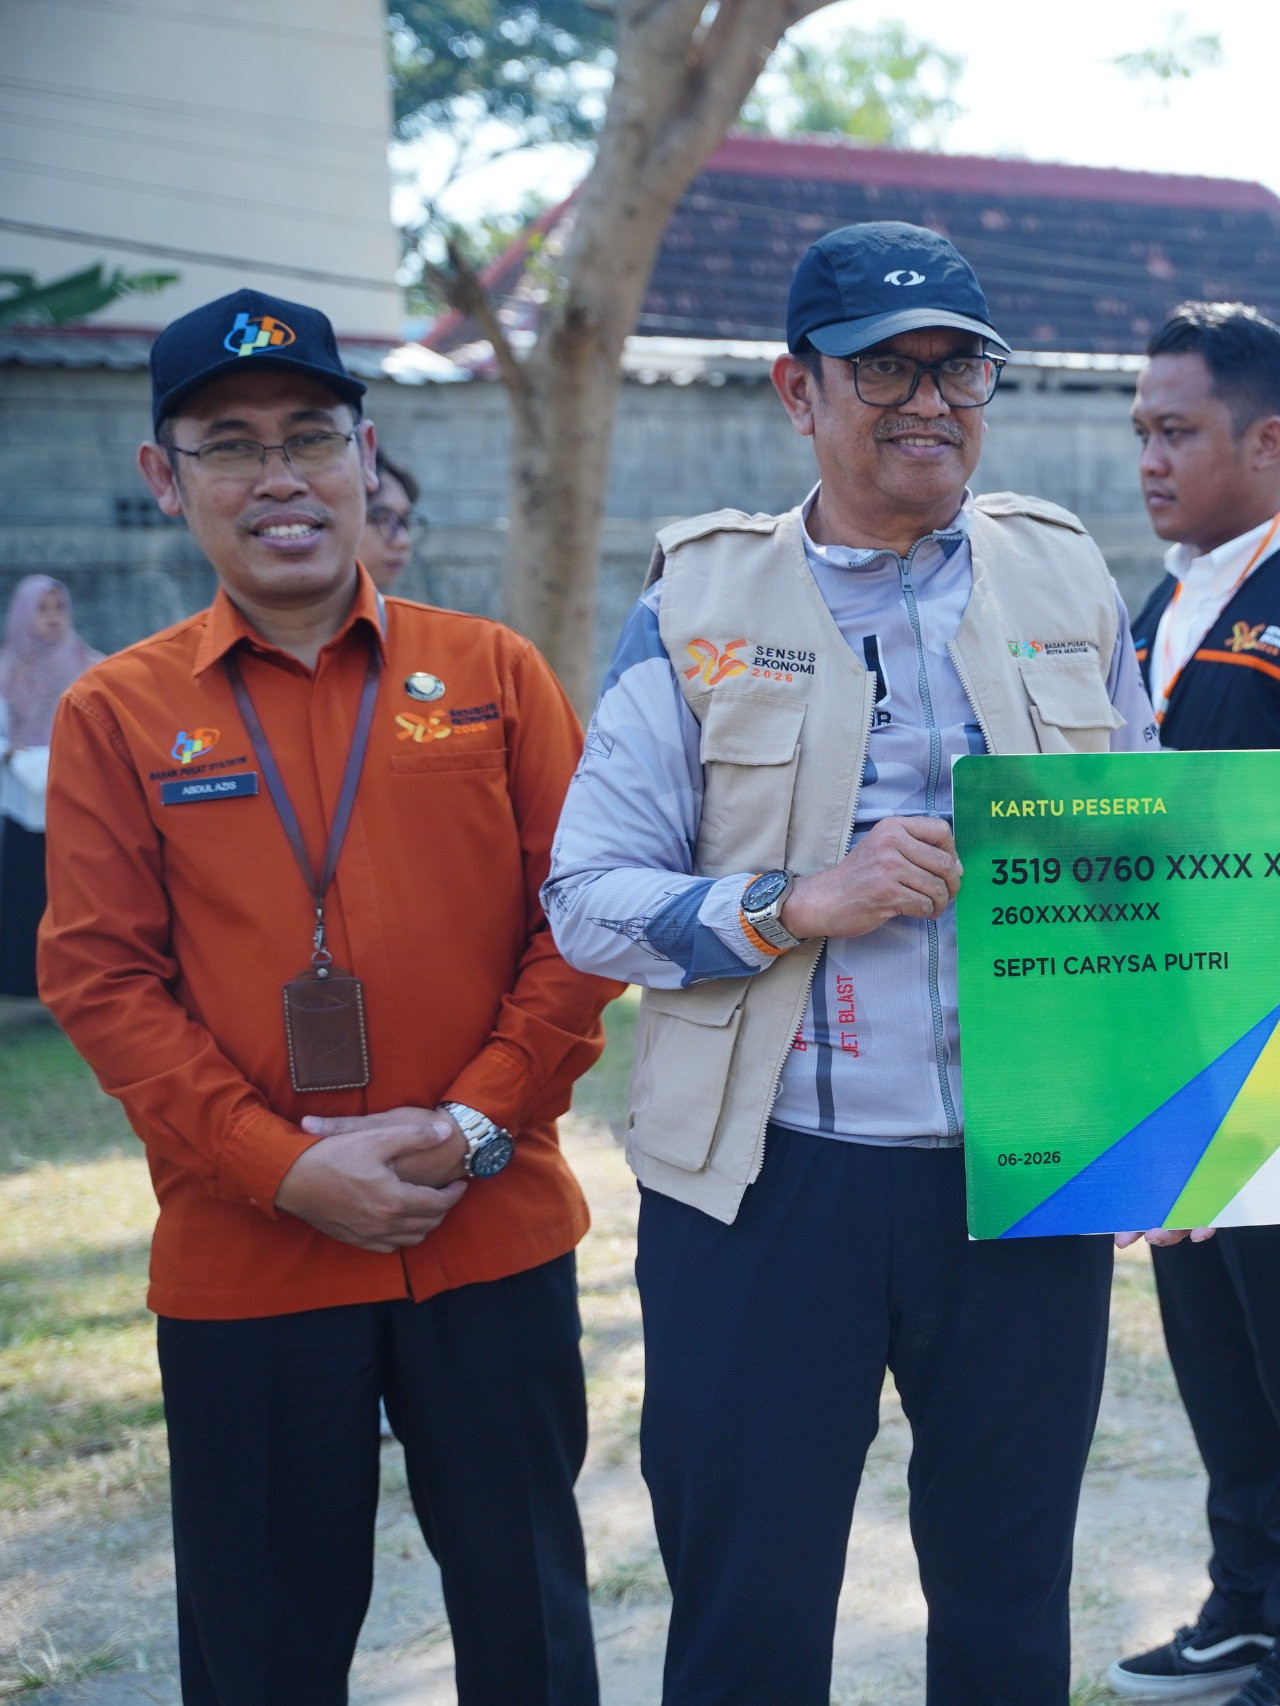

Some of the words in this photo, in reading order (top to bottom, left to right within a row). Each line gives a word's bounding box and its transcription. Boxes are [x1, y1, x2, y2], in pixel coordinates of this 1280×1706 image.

[756, 646, 816, 662] SENSUS
[752, 657, 815, 675] EKONOMI
[752, 668, 793, 683] 2026
[182, 784, 214, 795] ABDUL
[215, 781, 237, 791] AZIS
[990, 799, 1065, 817] KARTU
[1072, 797, 1168, 816] PESERTA
[991, 857, 1062, 885] 3519
[1072, 855, 1156, 882] 0760
[1165, 852, 1254, 881] XXXX
[991, 901, 1161, 925] 260XXXXXXXX
[993, 957, 1056, 977] SEPTI
[1063, 954, 1158, 975] CARYSA
[1164, 951, 1229, 971] PUTRI
[837, 975, 855, 1023] BLAST
[842, 1032, 859, 1058] JET
[997, 1151, 1062, 1167] 06-2026
